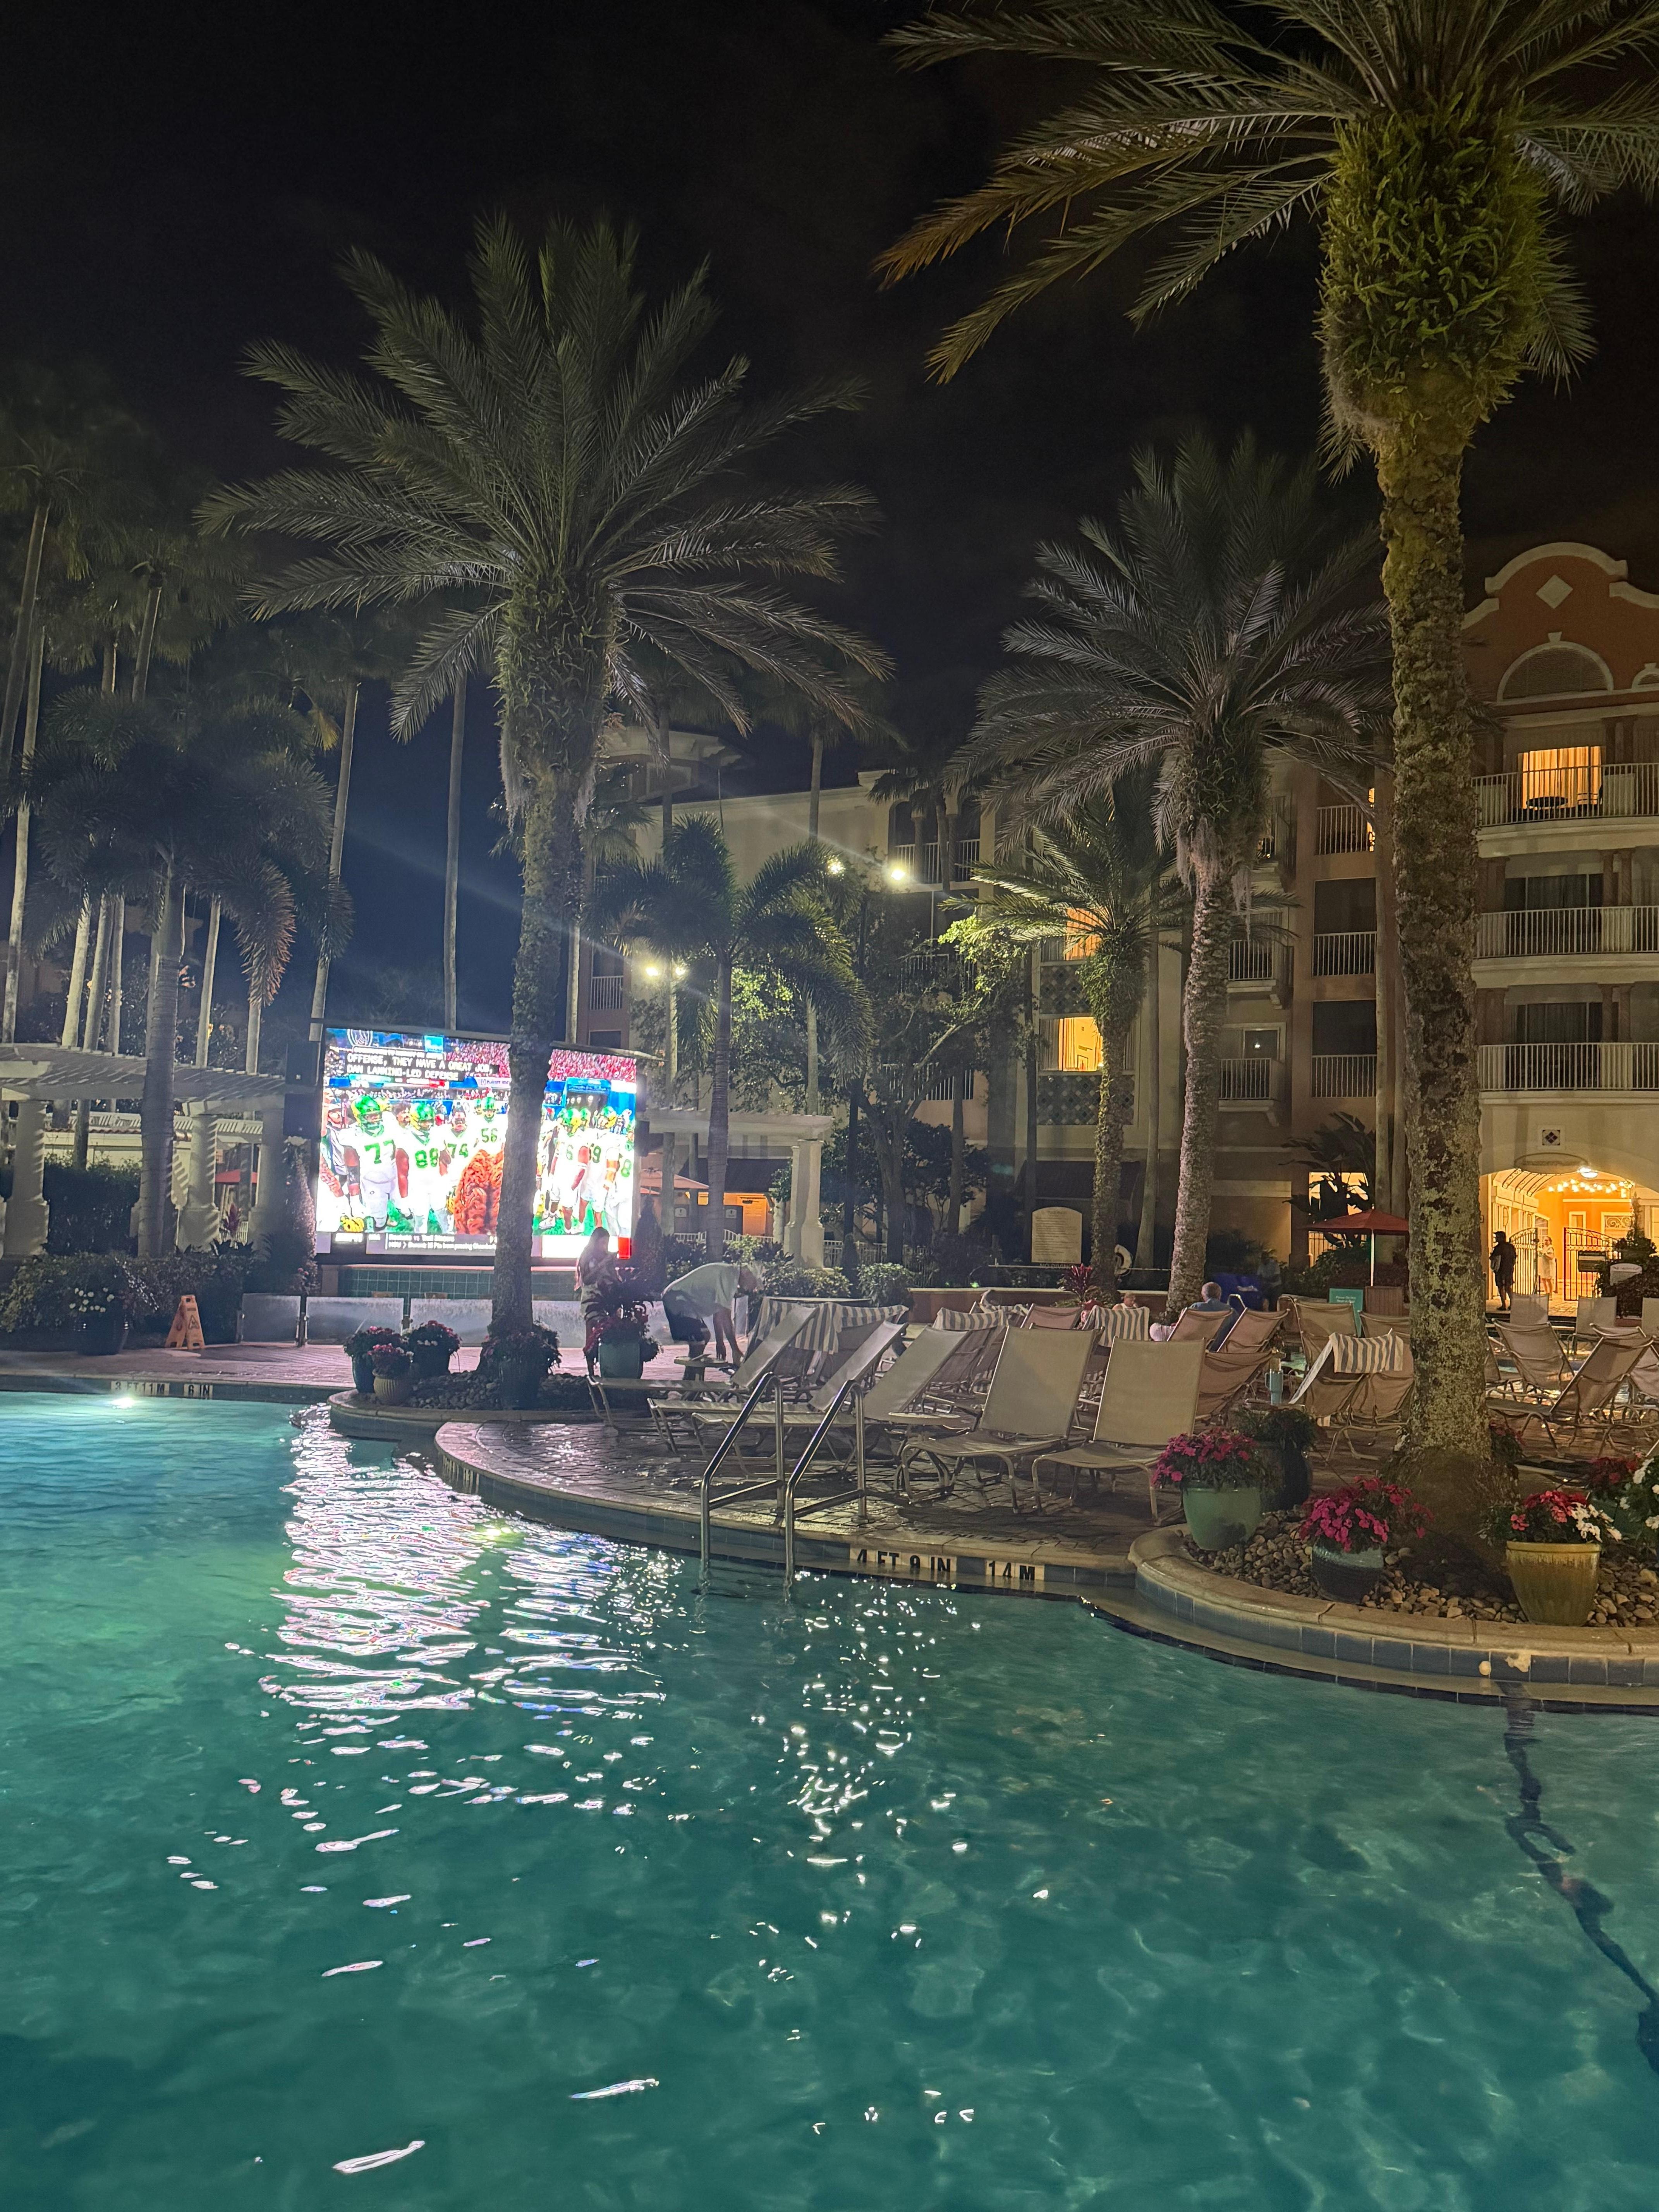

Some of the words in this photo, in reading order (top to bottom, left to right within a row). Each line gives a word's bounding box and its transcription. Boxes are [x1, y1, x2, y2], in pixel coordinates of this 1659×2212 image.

[347, 1053, 387, 1066] OFFENSE,
[392, 1056, 413, 1066] THEY
[416, 1058, 436, 1068] HAVE
[439, 1060, 445, 1069] A
[347, 1064, 364, 1073] DAN
[425, 1070, 459, 1081] DEFENSE
[481, 1128, 498, 1143] 56
[364, 1139, 396, 1164] 77
[415, 1147, 439, 1169] 88
[878, 1551, 900, 1566] FT
[931, 1557, 951, 1572] IN
